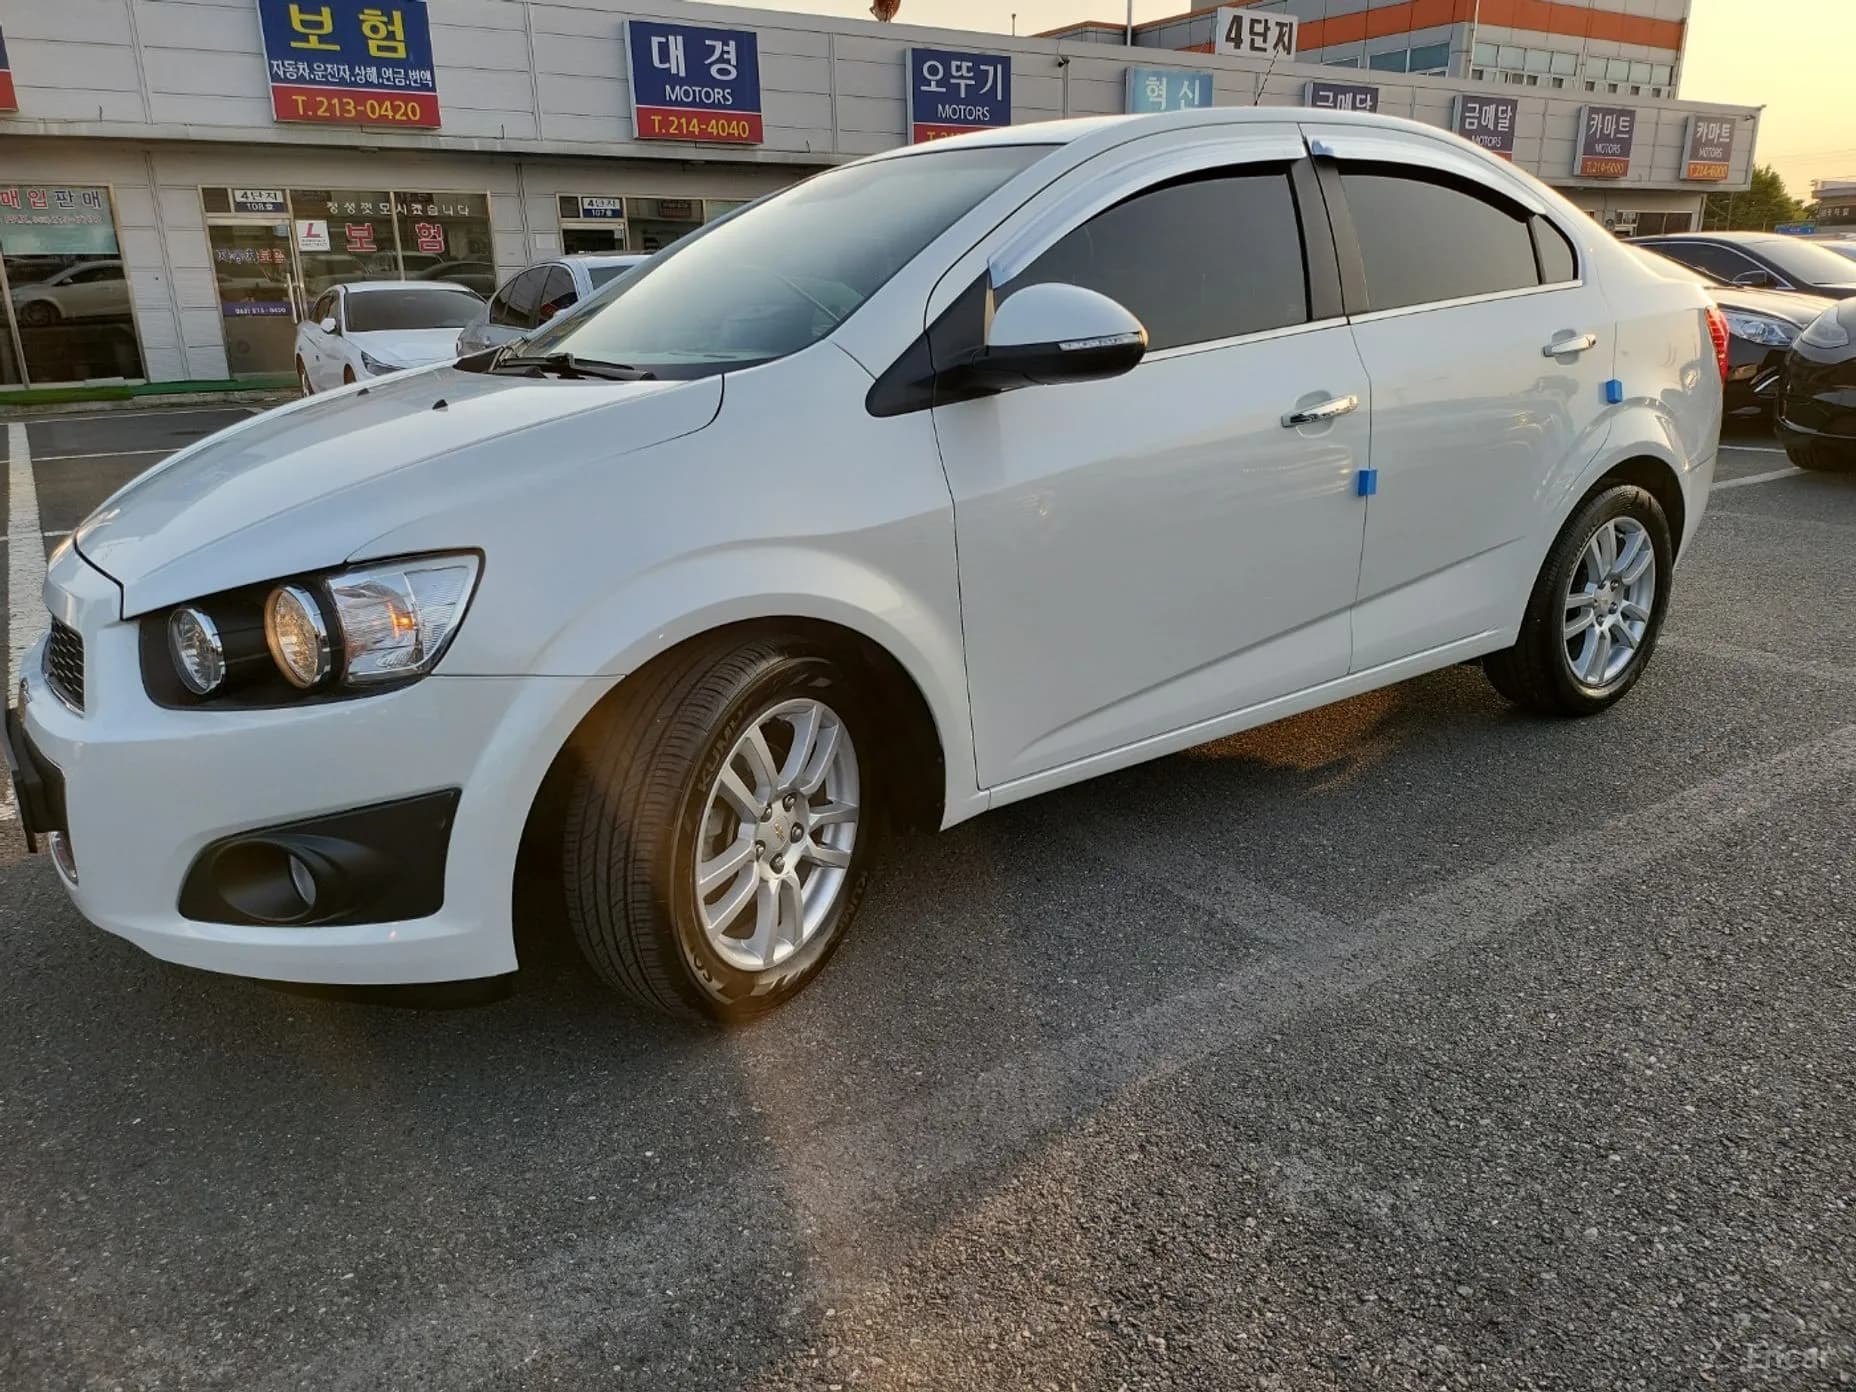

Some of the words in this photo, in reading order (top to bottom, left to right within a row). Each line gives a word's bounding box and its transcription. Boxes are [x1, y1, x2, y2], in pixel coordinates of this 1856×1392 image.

[289, 4, 407, 59] 보험
[1225, 15, 1293, 56] 4단지
[651, 35, 737, 80] 대경
[920, 60, 1002, 100] 오뚜기
[665, 84, 733, 105] MOTORS
[292, 95, 420, 121] T.213-0420
[937, 103, 990, 121] MOTORS
[650, 115, 749, 138] T.214-4040
[1588, 113, 1630, 139] 카마트
[1696, 121, 1731, 144] 카마트
[1472, 135, 1502, 148] MOTORS
[1595, 143, 1621, 154] MOTORS
